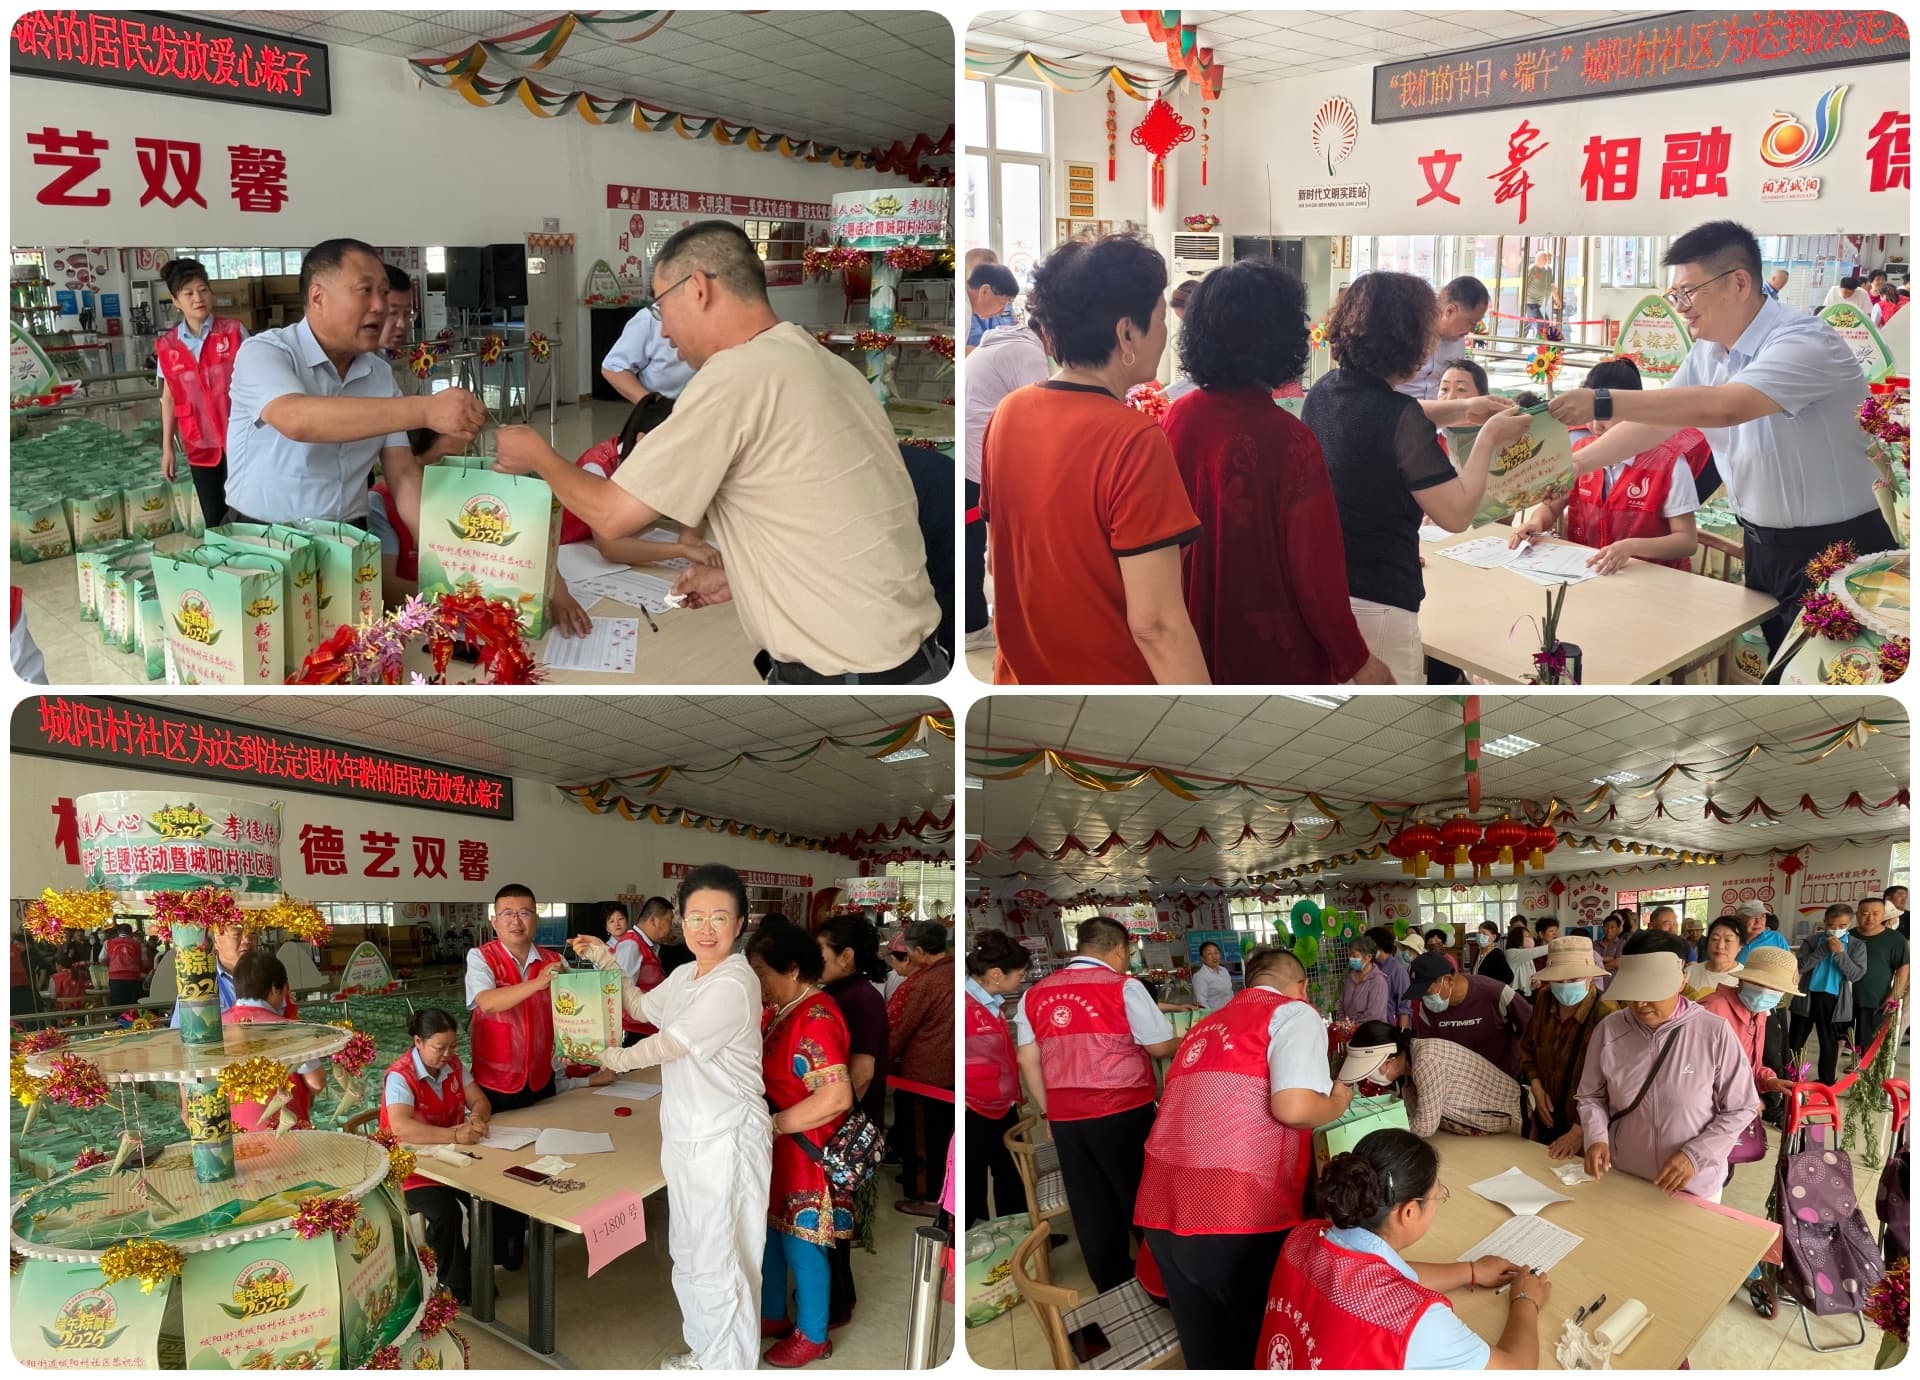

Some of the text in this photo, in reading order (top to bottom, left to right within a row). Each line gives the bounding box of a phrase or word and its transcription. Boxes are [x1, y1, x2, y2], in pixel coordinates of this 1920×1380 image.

[11, 10, 311, 96] 龄的居民发放爱心粽子
[27, 127, 289, 213] 艺双馨
[649, 190, 689, 211] 阳光城阳
[1298, 186, 1368, 201] 新时代文明实践站
[463, 526, 504, 545] 2026
[254, 622, 271, 679] 粽暖人心
[39, 695, 505, 810] 城阳村社区为达到法定退休年龄的居民发放爱心粽子
[160, 823, 205, 843] 2026
[83, 846, 281, 877] 午”主题活动暨城阳村社区第
[299, 824, 490, 882] 德艺双馨
[592, 1203, 638, 1243] 1-1800 号
[241, 1294, 290, 1322] 2026
[55, 1330, 105, 1351] 2026
